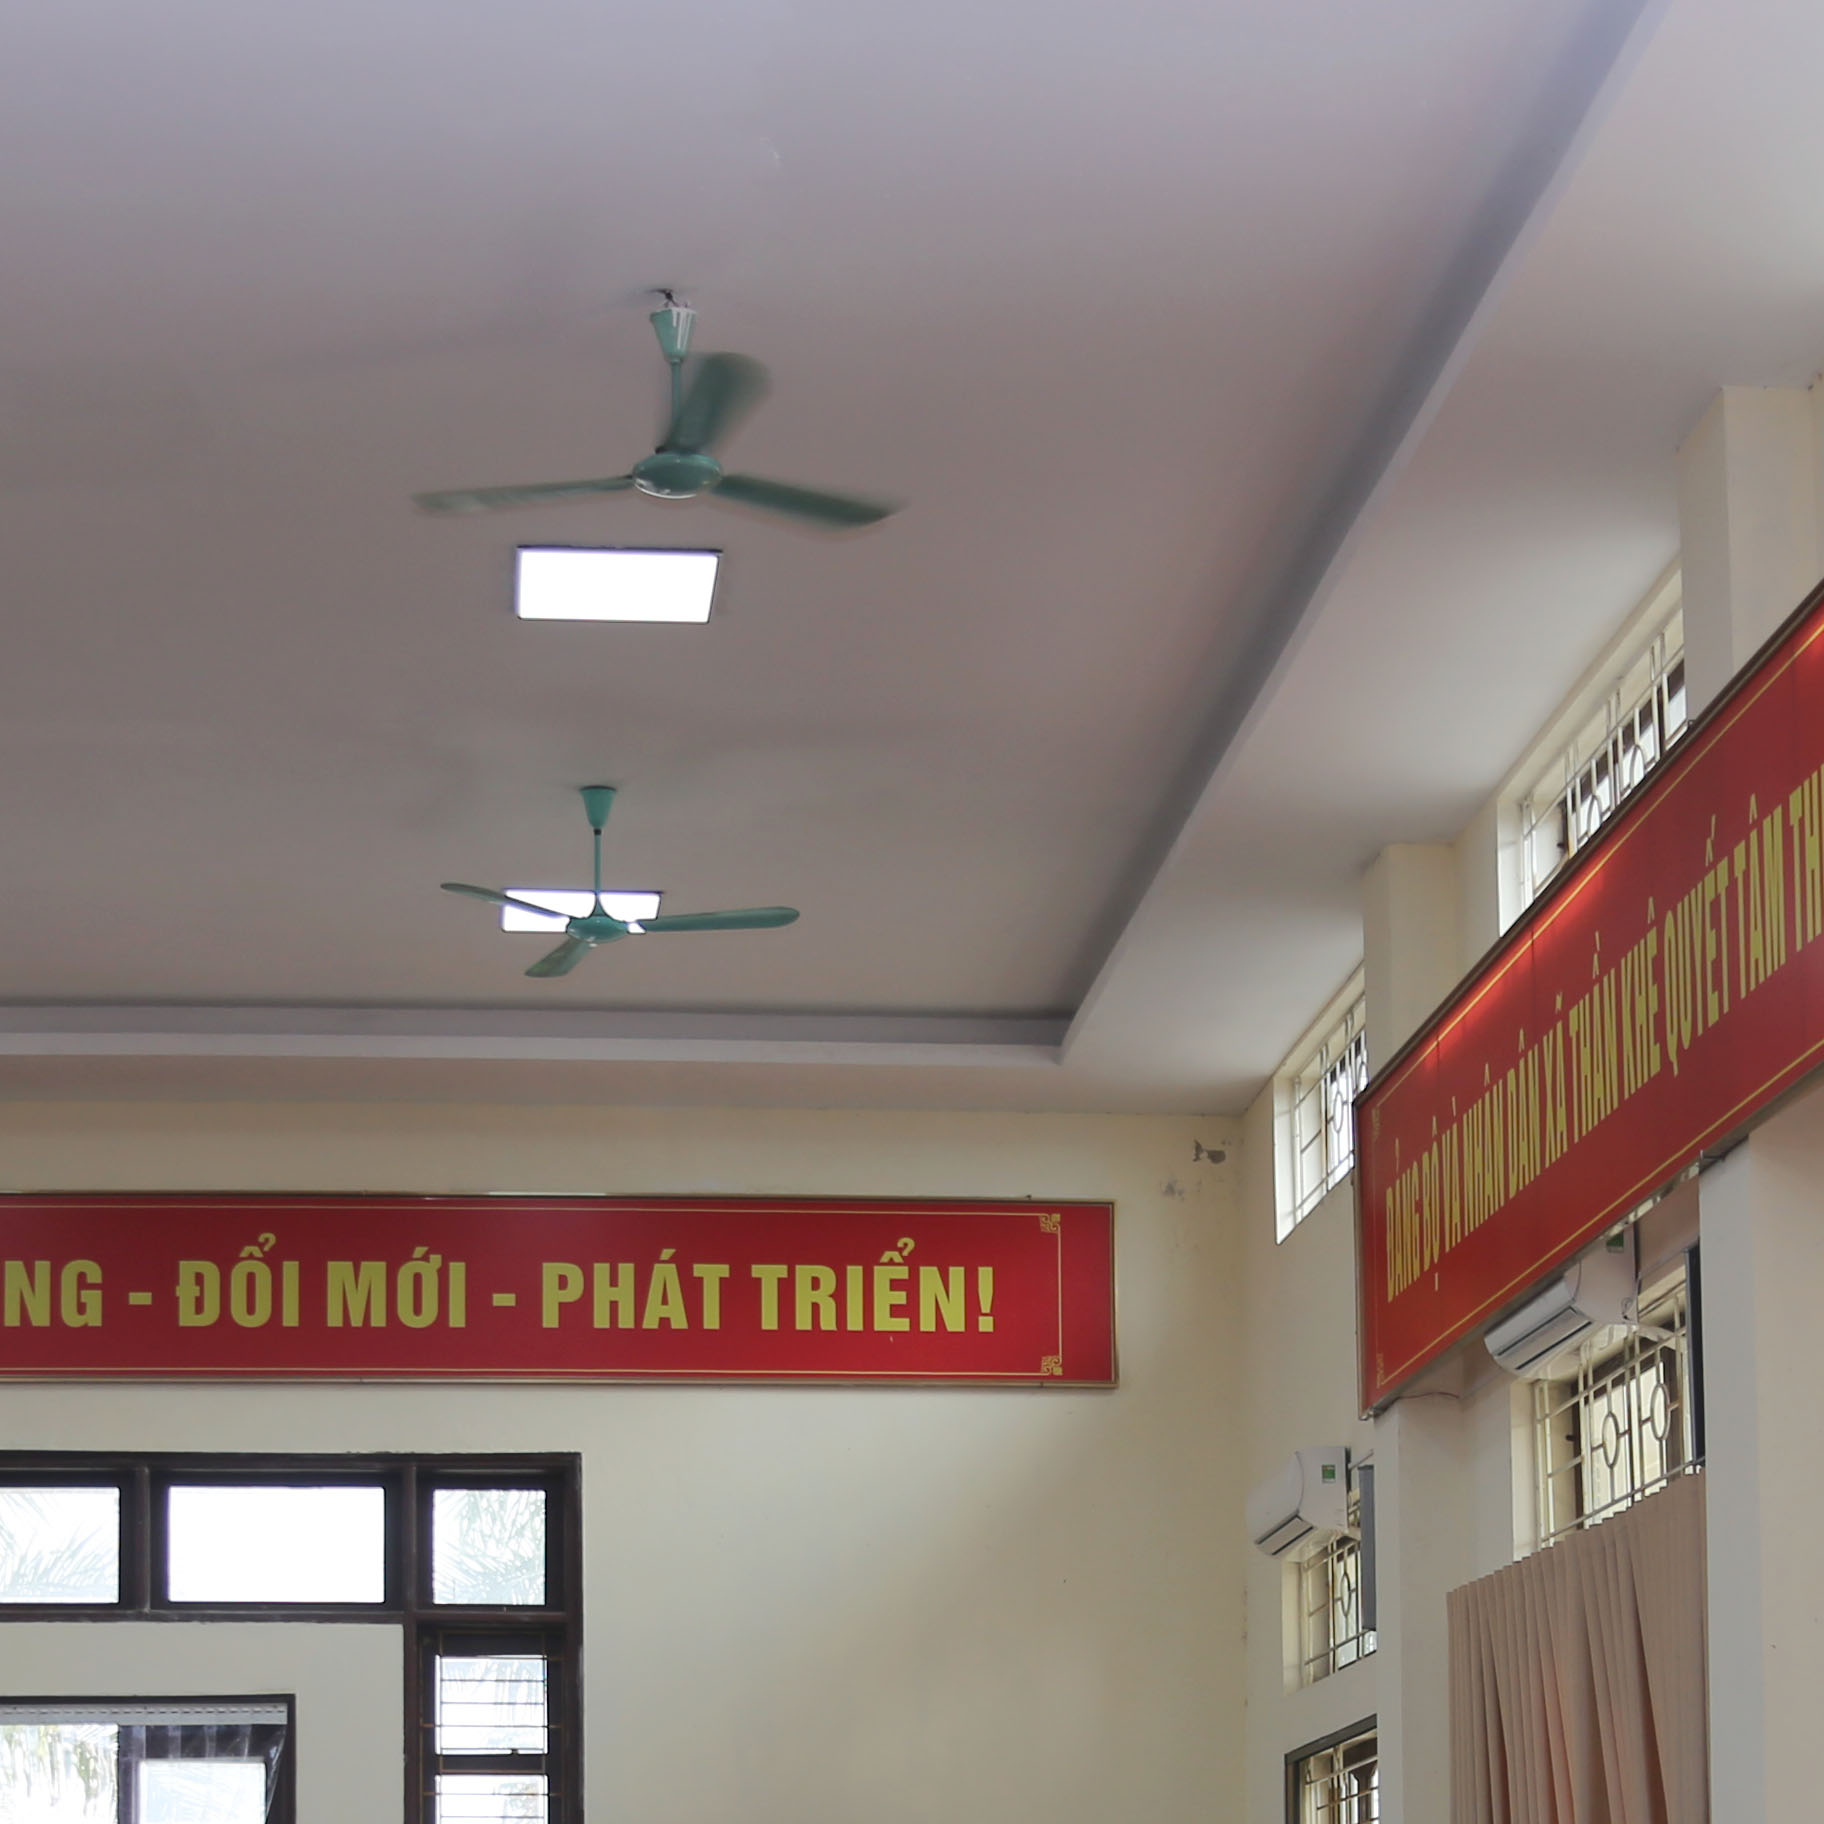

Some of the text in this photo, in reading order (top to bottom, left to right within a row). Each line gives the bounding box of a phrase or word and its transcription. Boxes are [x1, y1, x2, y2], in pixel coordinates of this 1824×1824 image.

[1385, 1137, 1421, 1303] ĐẢNG
[1422, 1114, 1441, 1292] BỘ
[1442, 1095, 1462, 1254] VÀ
[1463, 1062, 1505, 1238] NHÂN
[1507, 1027, 1541, 1201] DÂN
[1542, 991, 1569, 1169] XÃ
[1569, 930, 1619, 1145] THẦN
[1621, 896, 1661, 1101] KHÊ
[1664, 813, 1730, 1079] QUYẾT
[1733, 793, 1787, 1001] TÂM
[175, 1233, 301, 1328] ĐỔI
[327, 1246, 467, 1328] MỚI
[542, 1248, 732, 1331] PHÁT
[750, 1236, 996, 1333] TRIỂN!
